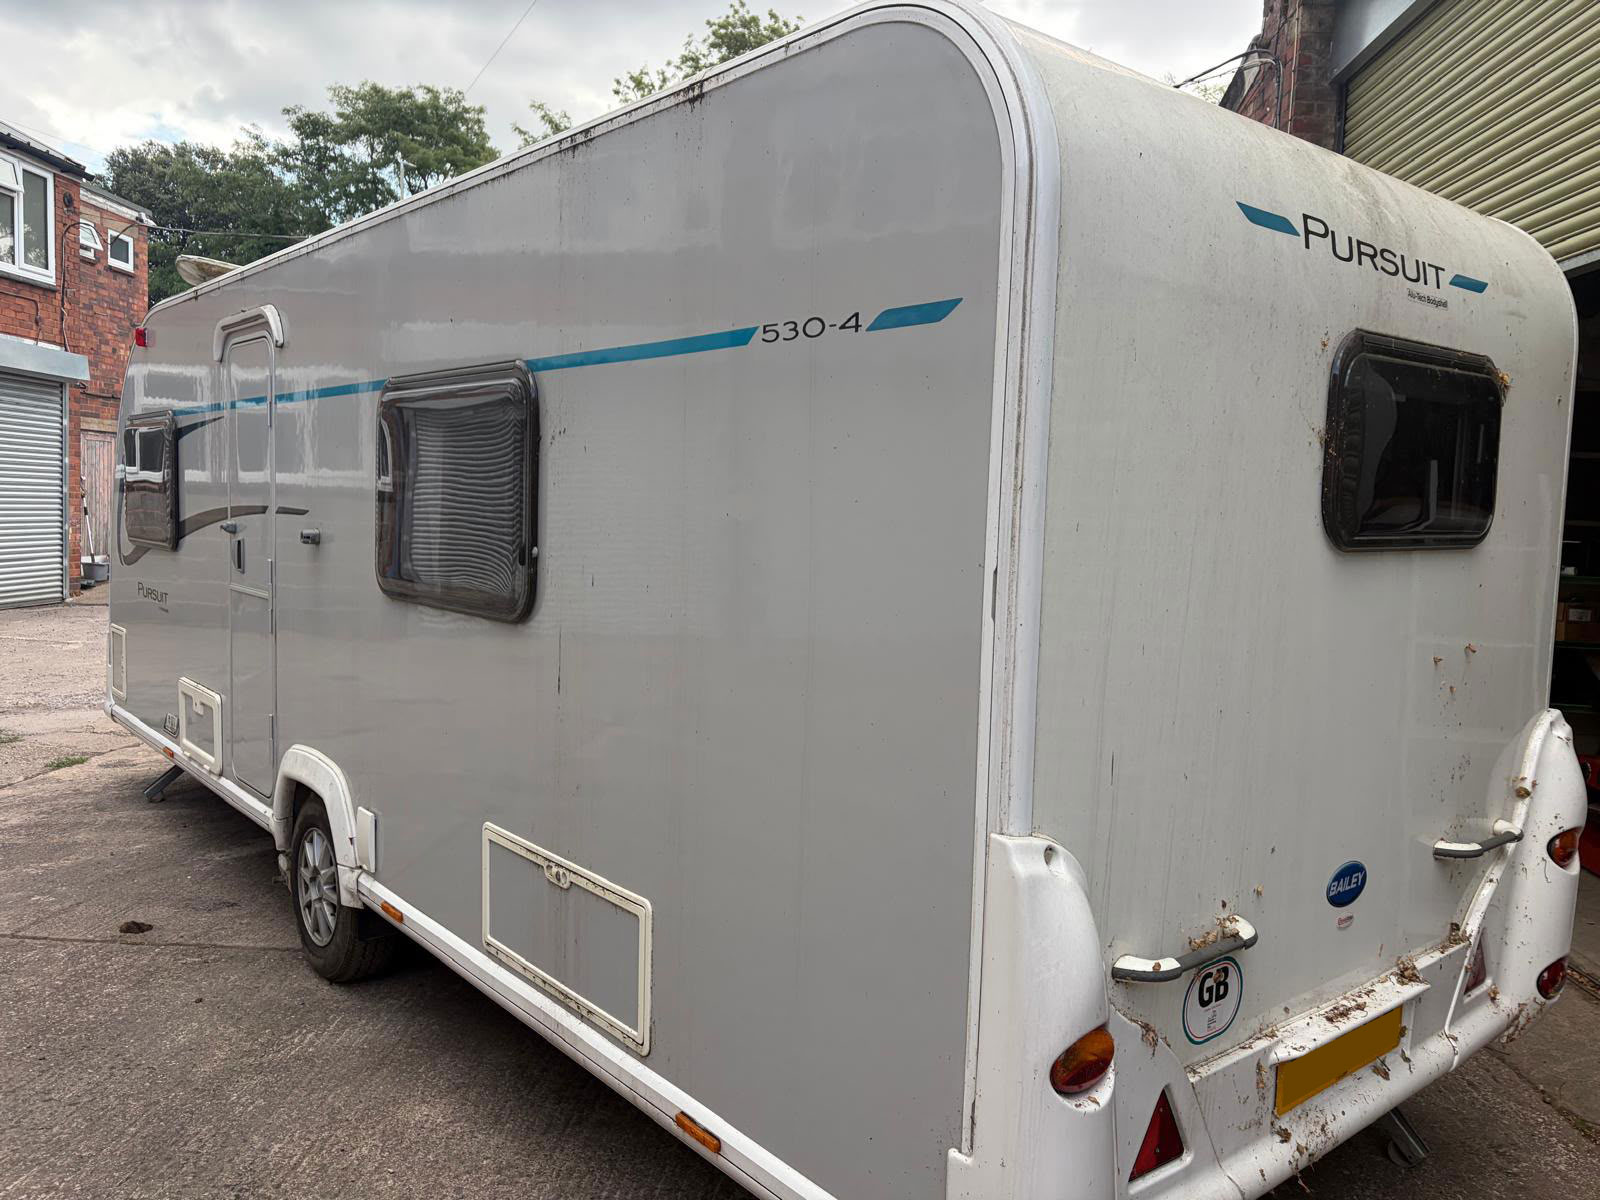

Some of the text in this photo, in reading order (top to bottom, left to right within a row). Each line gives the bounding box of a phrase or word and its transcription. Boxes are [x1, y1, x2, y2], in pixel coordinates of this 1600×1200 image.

[1302, 212, 1446, 290] PURSUIT
[761, 311, 862, 343] 530-4
[137, 581, 169, 606] PURSUIT
[1329, 870, 1365, 897] BAILEY
[1198, 966, 1229, 1008] GB
